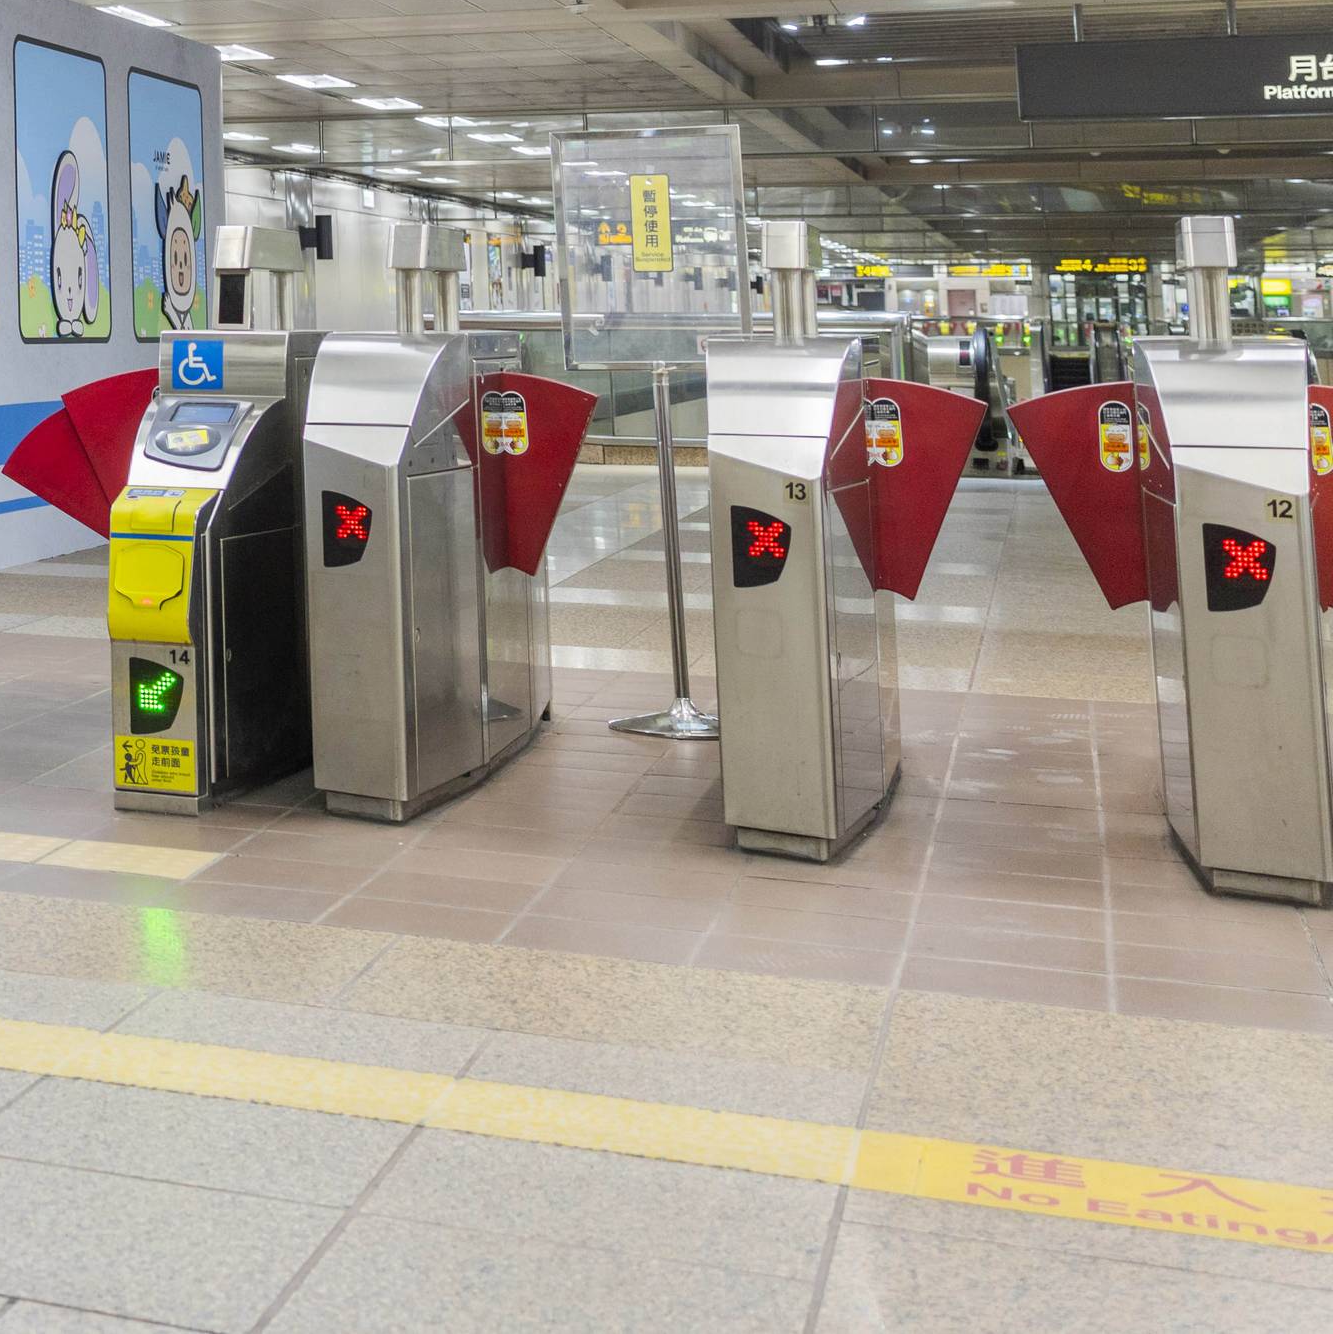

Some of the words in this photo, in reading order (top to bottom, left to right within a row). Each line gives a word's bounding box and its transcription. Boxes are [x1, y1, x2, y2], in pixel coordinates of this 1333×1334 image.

[642, 189, 659, 248] 暫停使用
[784, 480, 807, 501] 13
[1266, 498, 1293, 520] 12
[169, 649, 190, 665] 14
[966, 1182, 1060, 1207] No
